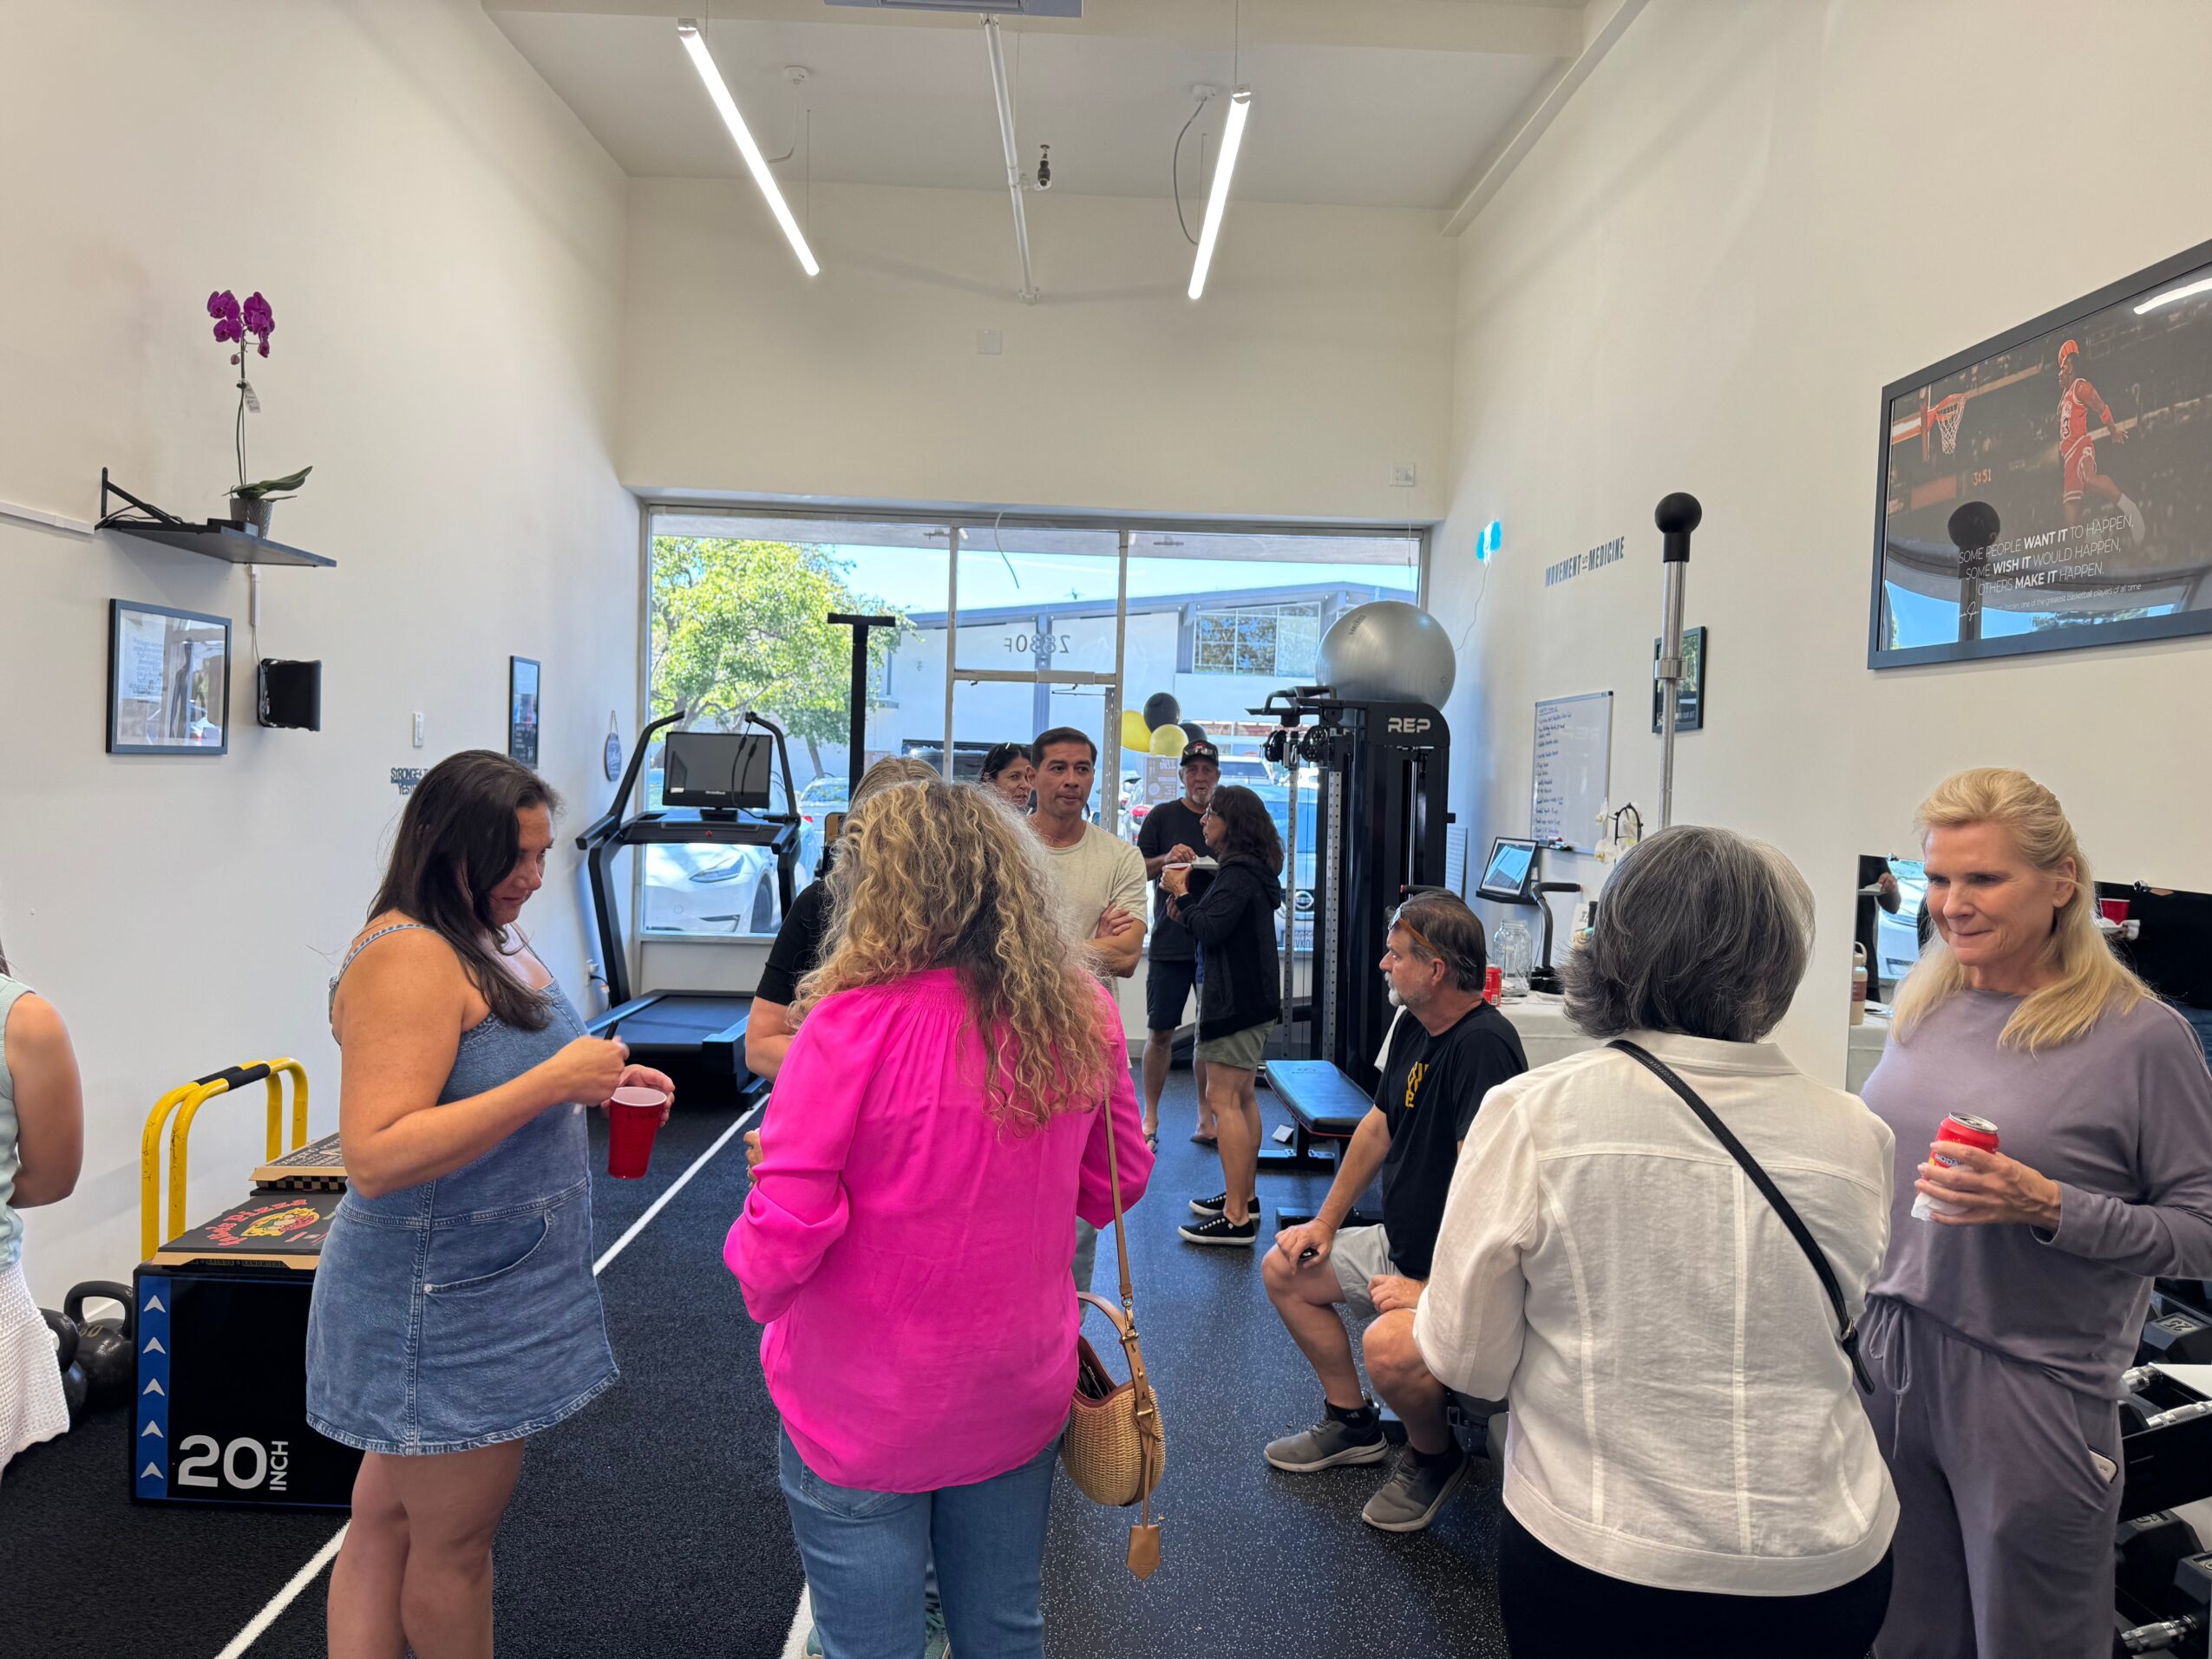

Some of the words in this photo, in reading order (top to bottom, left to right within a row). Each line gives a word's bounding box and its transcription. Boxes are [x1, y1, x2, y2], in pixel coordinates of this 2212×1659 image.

[1959, 547, 1983, 564] SOME
[1986, 539, 2022, 558] PEOPLE
[2024, 532, 2056, 550] WANT
[2058, 528, 2069, 543] IT
[2070, 525, 2084, 540] TO
[2086, 513, 2134, 536] HAPPEN,
[1966, 565, 1991, 581] SOME
[1993, 558, 2019, 574] WISH
[2021, 556, 2032, 570] IT
[2032, 547, 2072, 567] WOULD
[2074, 537, 2122, 558] HAPPEN,
[1545, 554, 1581, 587] MOVEMENT
[1588, 536, 1625, 572] MEDICINE
[1978, 578, 2013, 596] OTHERS
[2014, 572, 2045, 589] MAKE
[2046, 570, 2058, 585] IT
[2059, 562, 2105, 582] HAPPEN.
[2037, 597, 2045, 605] the
[2045, 595, 2066, 606] greatest
[2066, 590, 2093, 601] basketball
[2094, 587, 2113, 598] players
[2113, 585, 2119, 594] of
[1388, 717, 1430, 733] REP
[178, 1434, 267, 1489] 20
[269, 1440, 289, 1491] INCH
